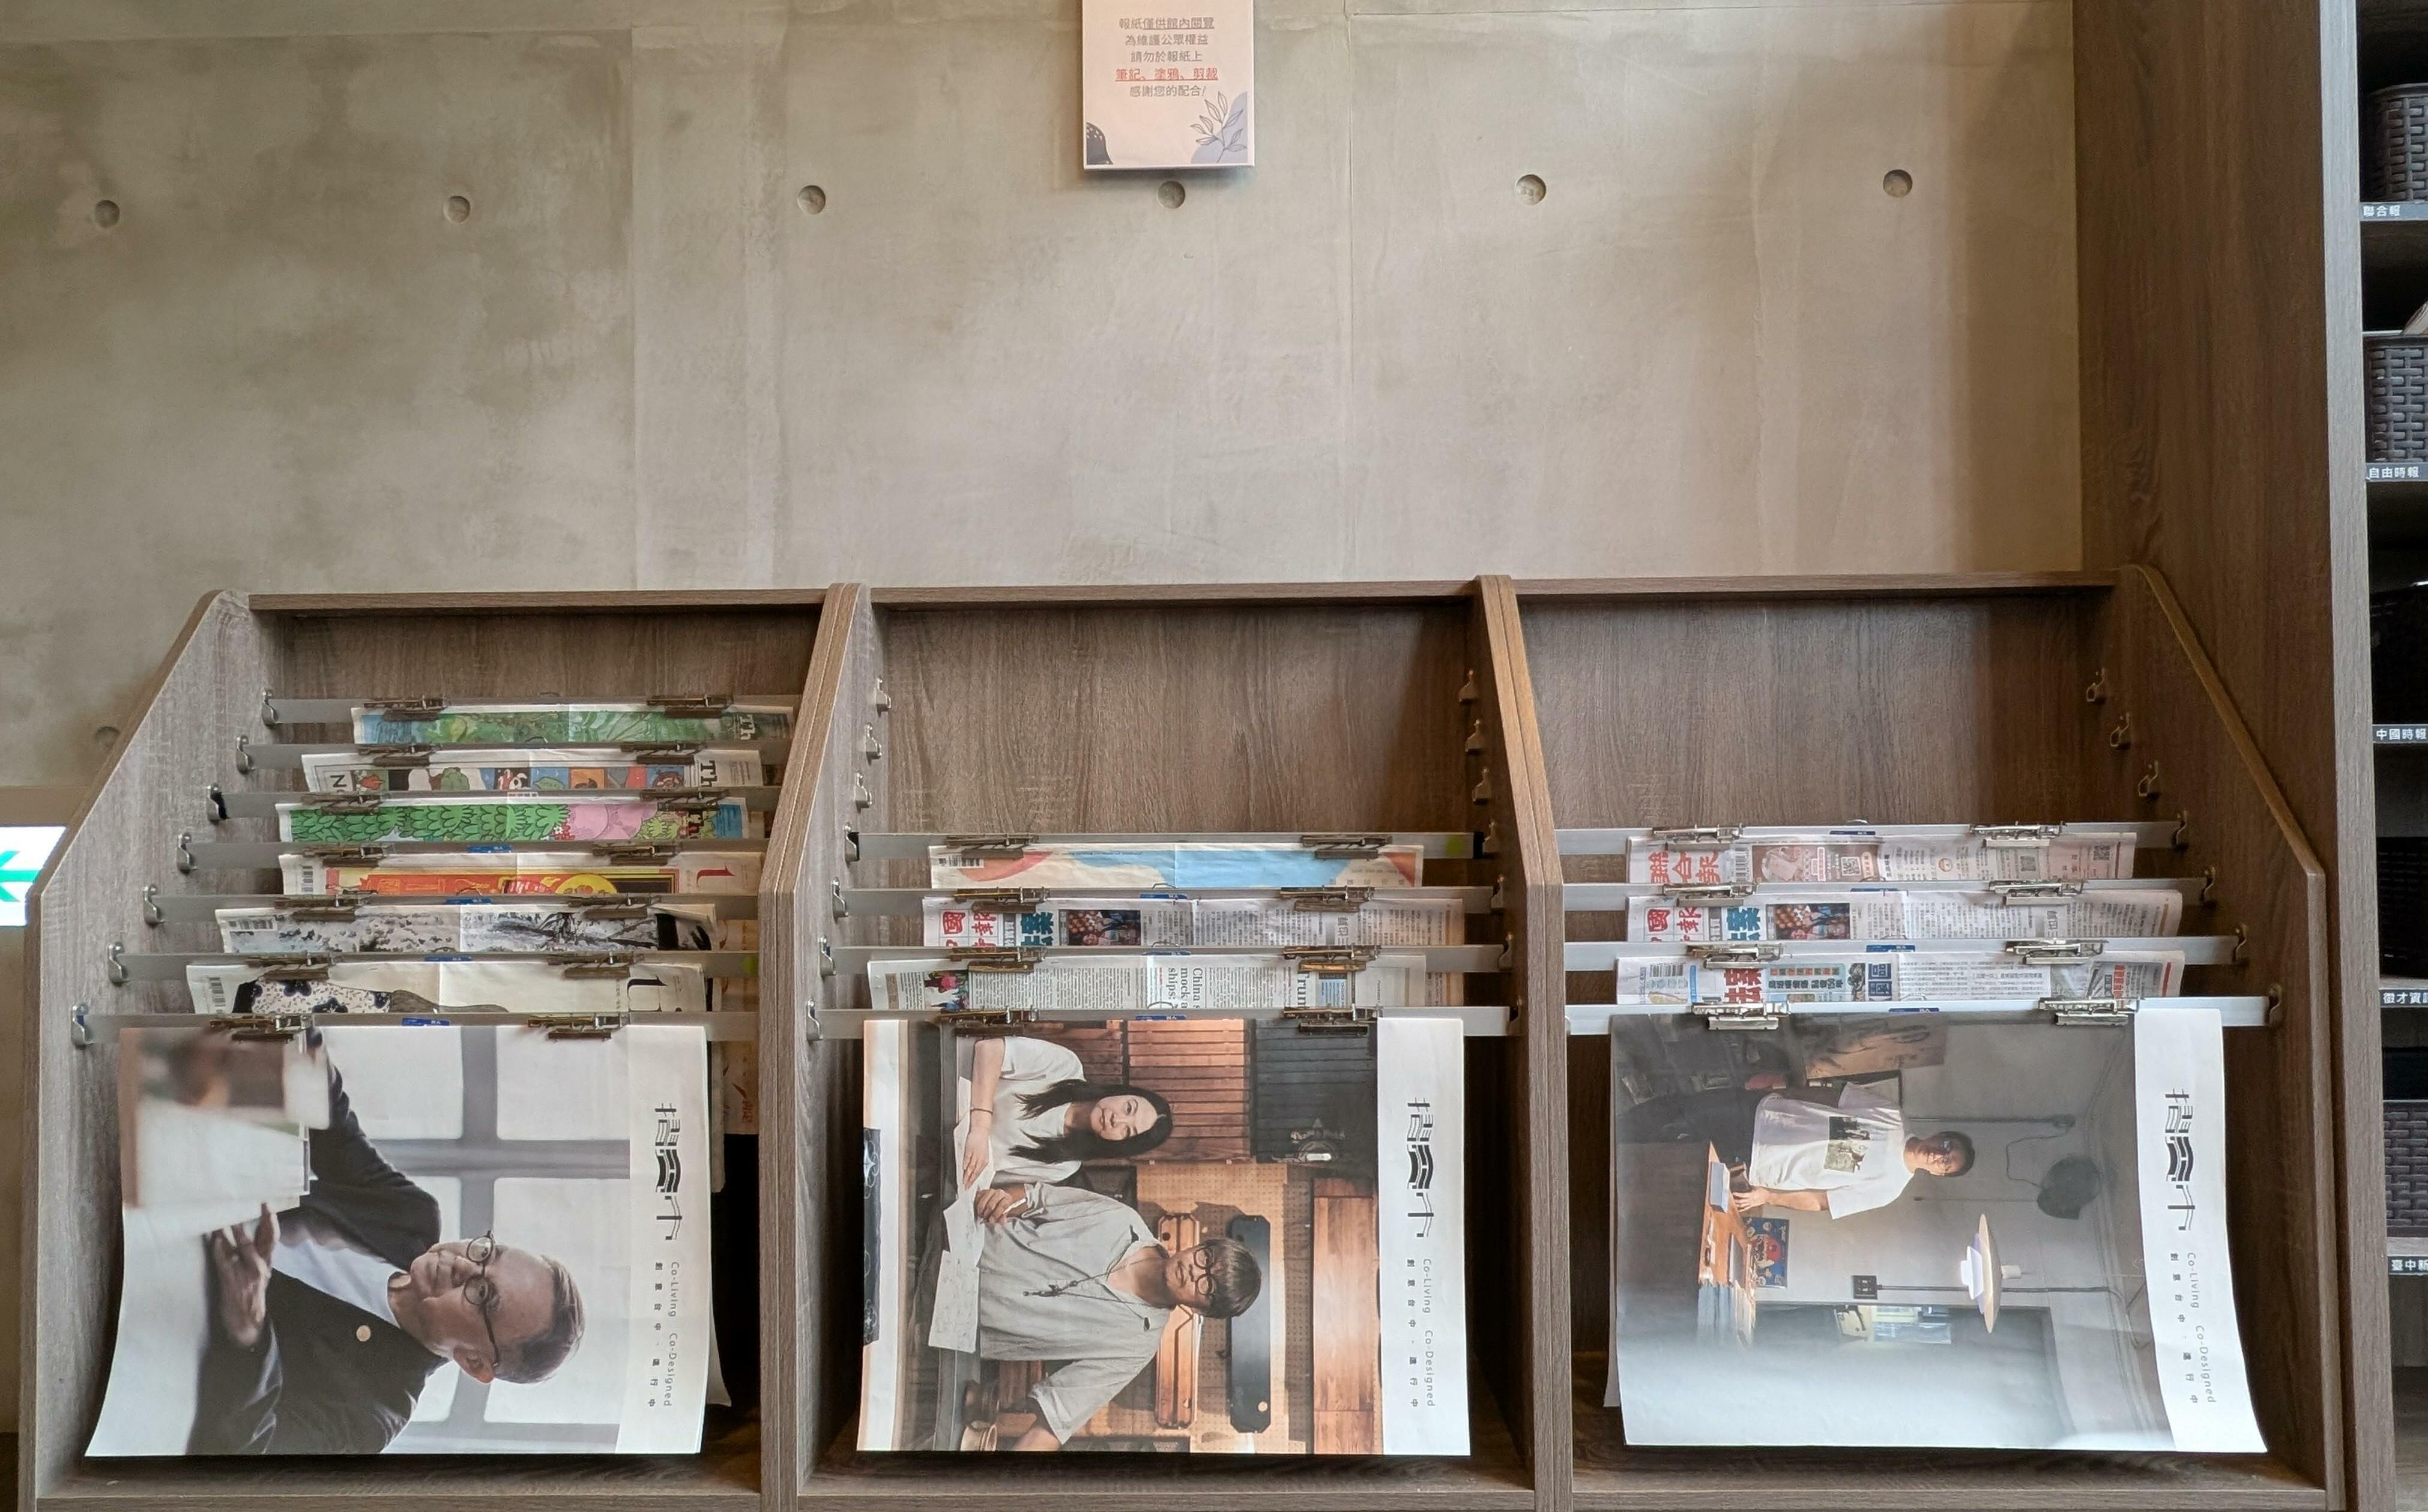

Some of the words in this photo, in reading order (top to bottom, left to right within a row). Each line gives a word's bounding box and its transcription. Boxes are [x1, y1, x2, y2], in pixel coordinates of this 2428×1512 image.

[1125, 34, 1208, 46] 為維護公眾權益
[1131, 51, 1203, 62] 請勿於報紙上
[2363, 205, 2400, 217] 聯合報
[2369, 466, 2419, 478] 自由時報
[2376, 728, 2427, 740] 中國時報
[1648, 849, 1721, 884] 聯合報
[1166, 968, 1178, 999] ships:
[1180, 968, 1191, 999] mock
[1192, 968, 1203, 1002] China
[668, 1262, 679, 1318] Co-Living
[1422, 1258, 1432, 1313] Co-Living
[2187, 1252, 2199, 1309] Co-Living
[2196, 1325, 2217, 1403] Co-Designed
[663, 1333, 678, 1406] Co-Designed
[1424, 1330, 1436, 1406] Co-Designed
